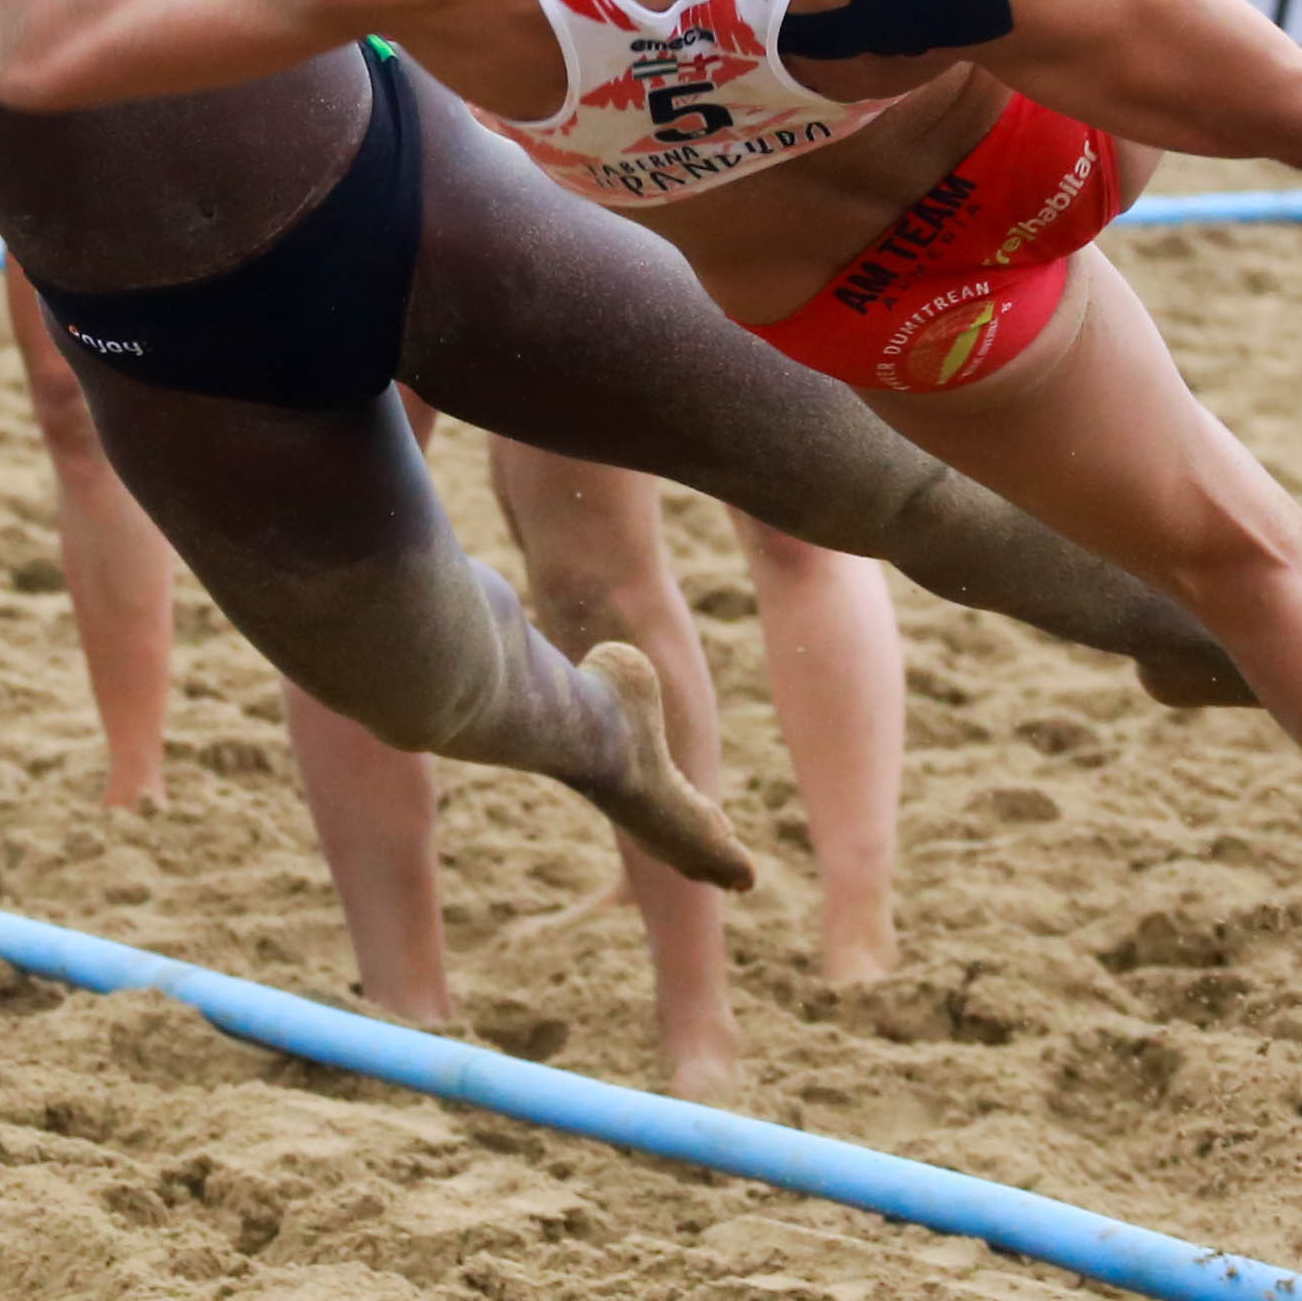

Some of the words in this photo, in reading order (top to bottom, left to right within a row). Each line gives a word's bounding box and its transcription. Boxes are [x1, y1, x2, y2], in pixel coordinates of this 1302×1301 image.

[648, 81, 734, 143] 5
[834, 260, 900, 316] AM
[877, 172, 977, 260] TEAM
